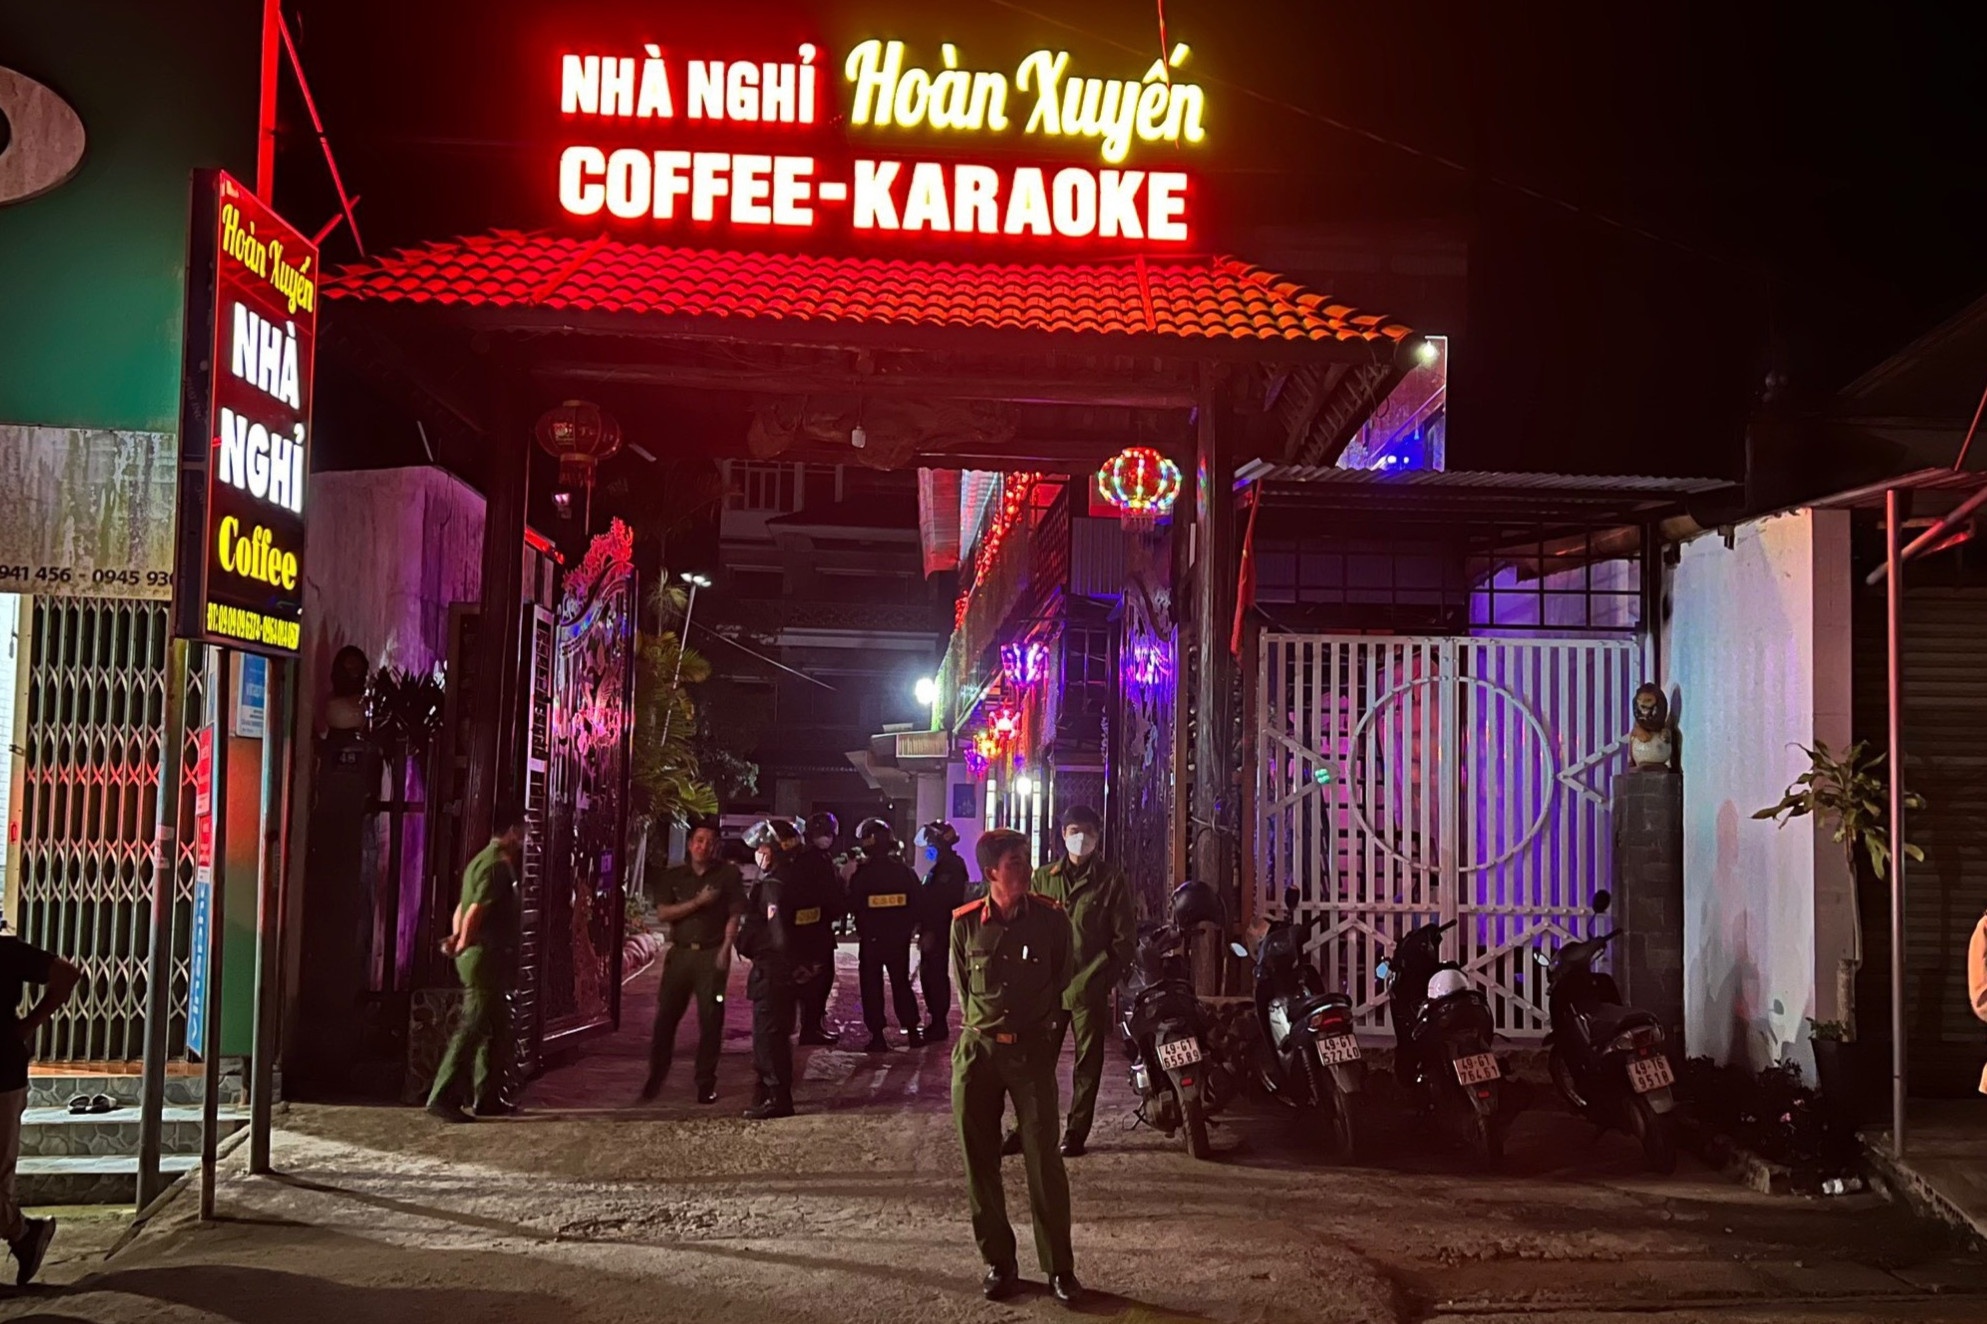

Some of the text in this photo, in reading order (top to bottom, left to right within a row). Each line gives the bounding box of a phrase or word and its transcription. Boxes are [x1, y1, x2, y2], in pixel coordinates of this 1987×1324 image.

[561, 43, 816, 124] NHÀ NGHỈ
[845, 40, 1205, 163] Hoàn Xuyến
[559, 146, 1188, 240] COFFEE-KARAOKE
[222, 203, 314, 314] Hoàn Xuyến
[232, 302, 299, 410] NHÀ
[219, 407, 305, 514] NGHỈ
[34, 566, 72, 582] 456
[92, 569, 140, 586] 0945
[219, 515, 298, 591] Coffee
